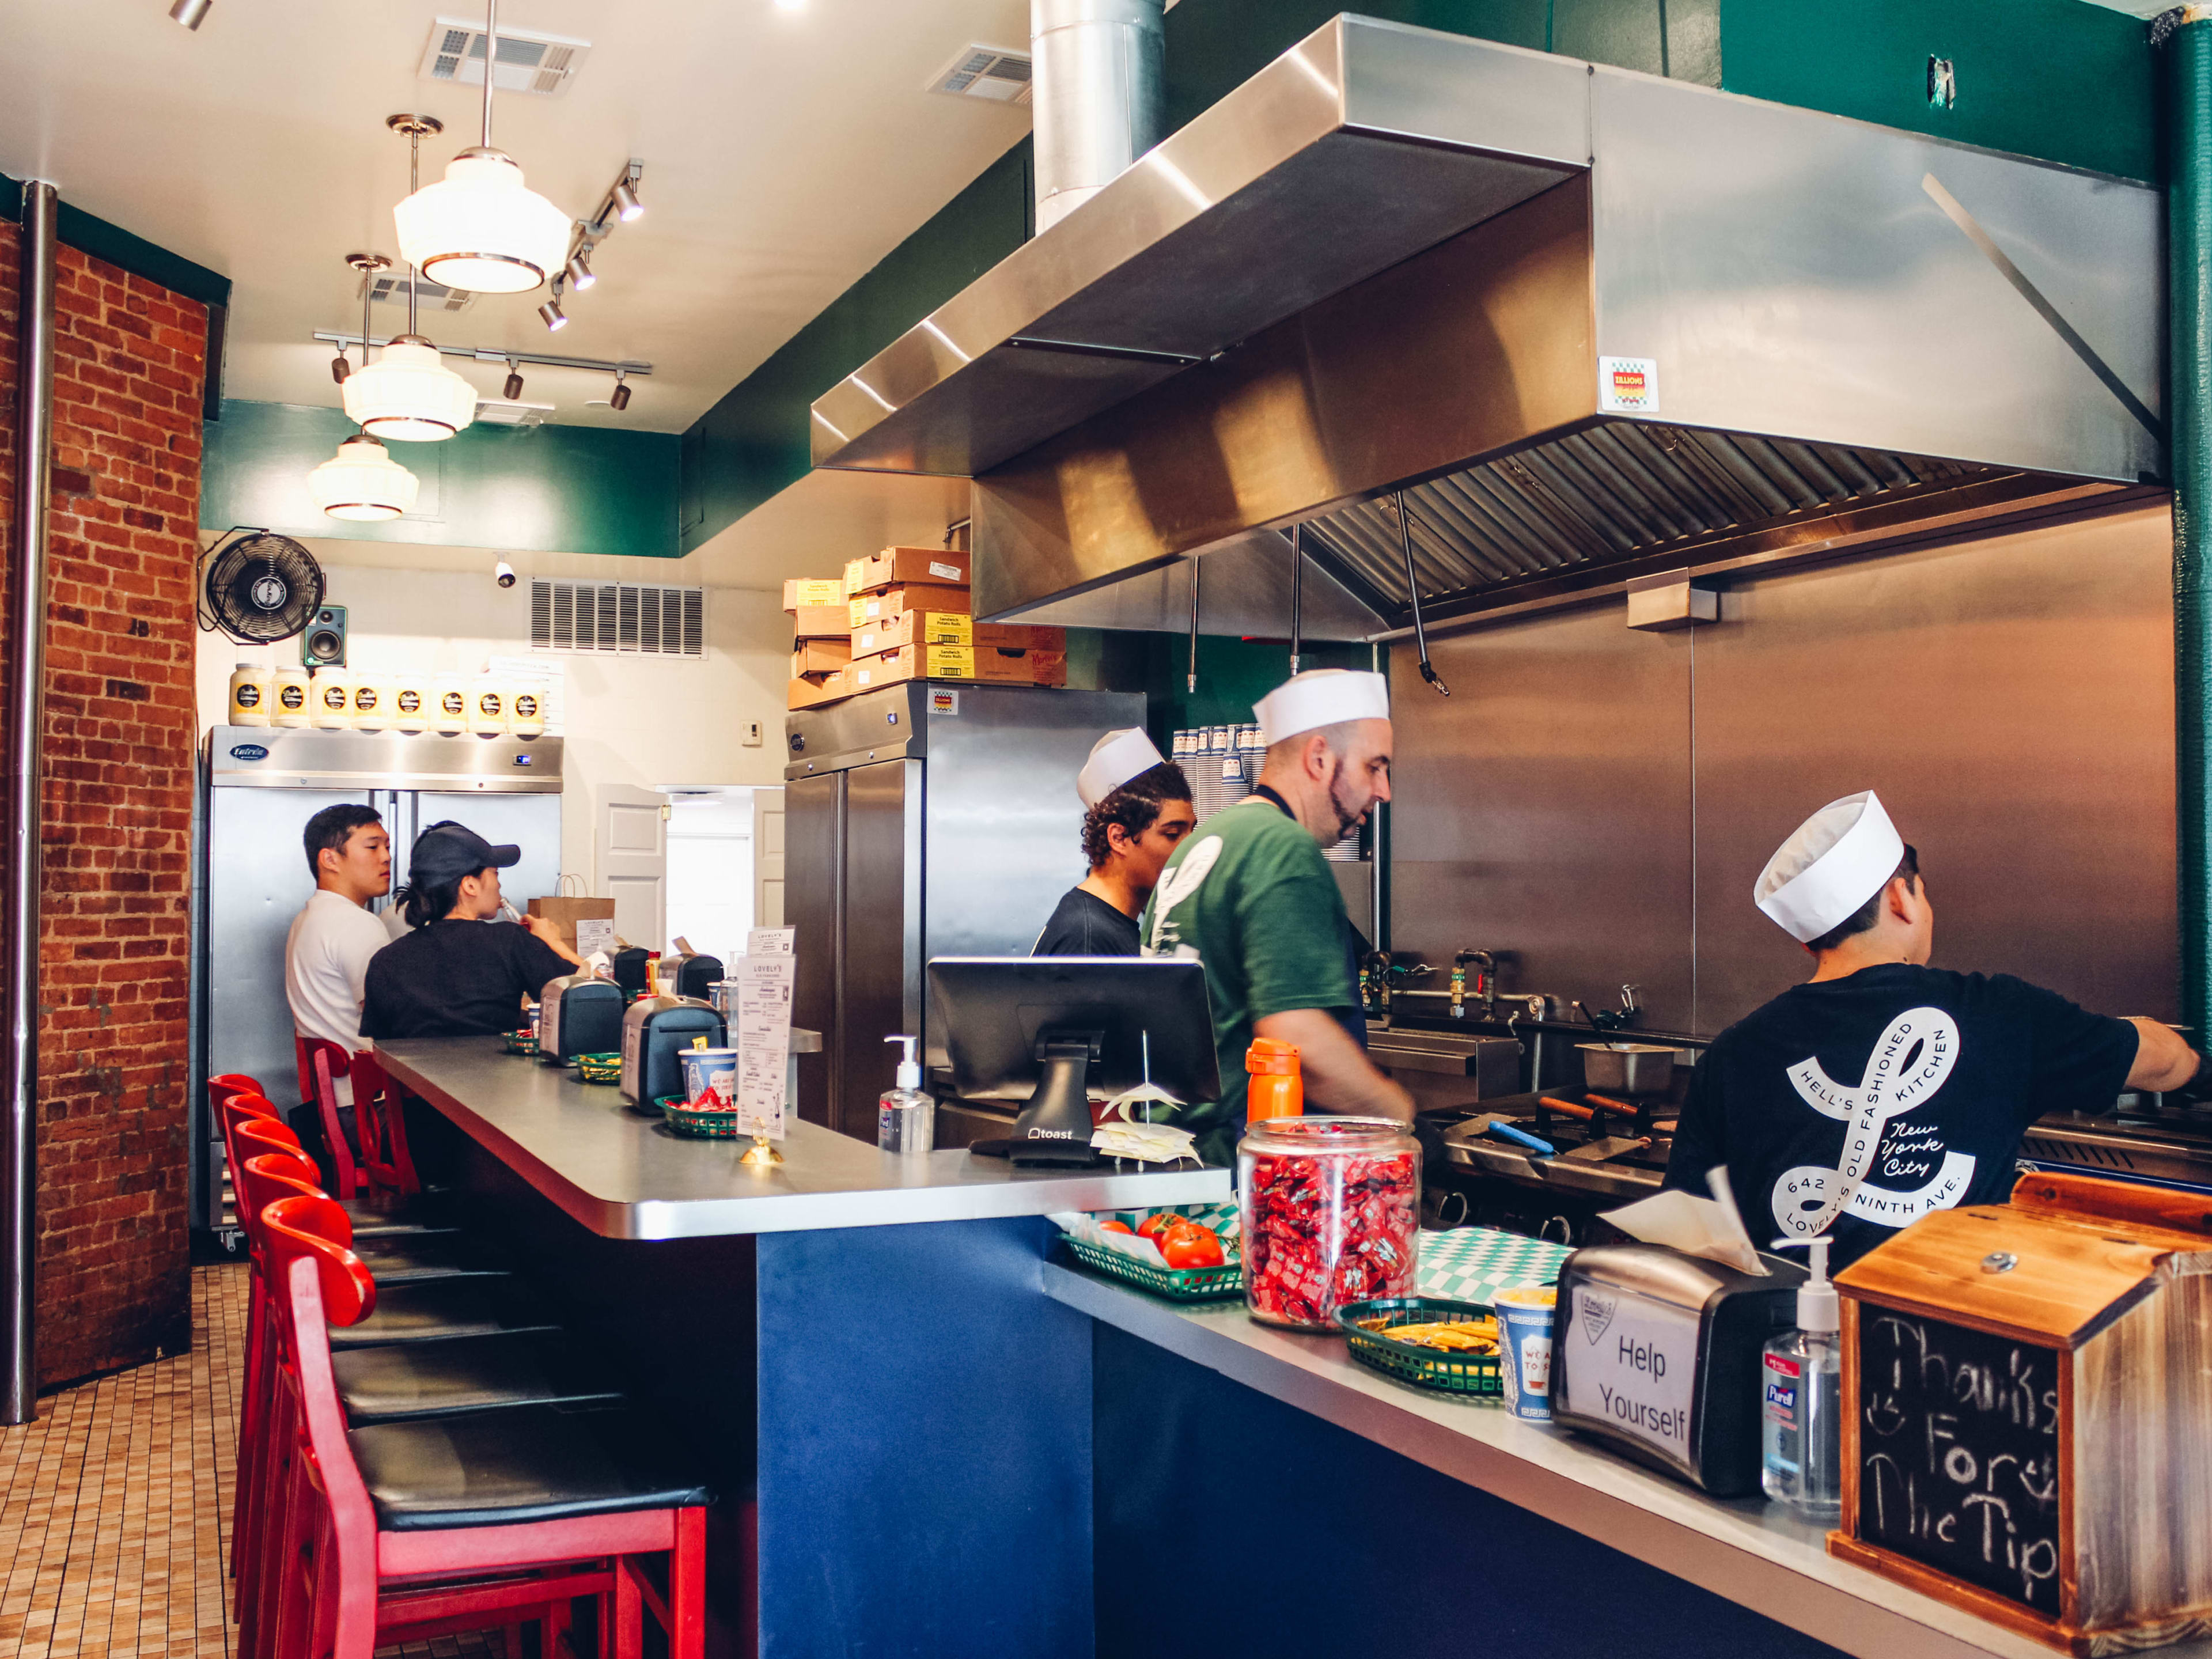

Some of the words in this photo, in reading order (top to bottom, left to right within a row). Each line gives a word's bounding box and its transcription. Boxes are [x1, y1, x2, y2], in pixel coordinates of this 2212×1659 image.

[753, 964, 782, 972] LOVELY'S
[1800, 1070, 1853, 1111] HELL'S
[1895, 1028, 1947, 1103] KITCHEN
[1040, 1129, 1073, 1140] toast
[1786, 1187, 1850, 1232] LOVELY'S
[1847, 1139, 1866, 1177] OLD
[1861, 1022, 1912, 1130] FASHIONED
[1891, 1122, 1939, 1138] New
[1881, 1139, 1944, 1161] York
[1884, 1158, 1930, 1177] City
[1788, 1178, 1825, 1194] 642
[1855, 1192, 1915, 1214] NINTH
[1926, 1175, 1961, 1210] AVE.
[1524, 1362, 1538, 1370] TO
[1526, 1351, 1540, 1359] WE
[1618, 1334, 1666, 1384] Help
[1872, 1316, 2058, 1434] Thanks
[1769, 1385, 1793, 1407] Purell
[1599, 1382, 1686, 1442] Yourself
[1926, 1413, 2017, 1493] For
[1866, 1453, 1957, 1544] The
[1961, 1494, 2058, 1601] Tip
